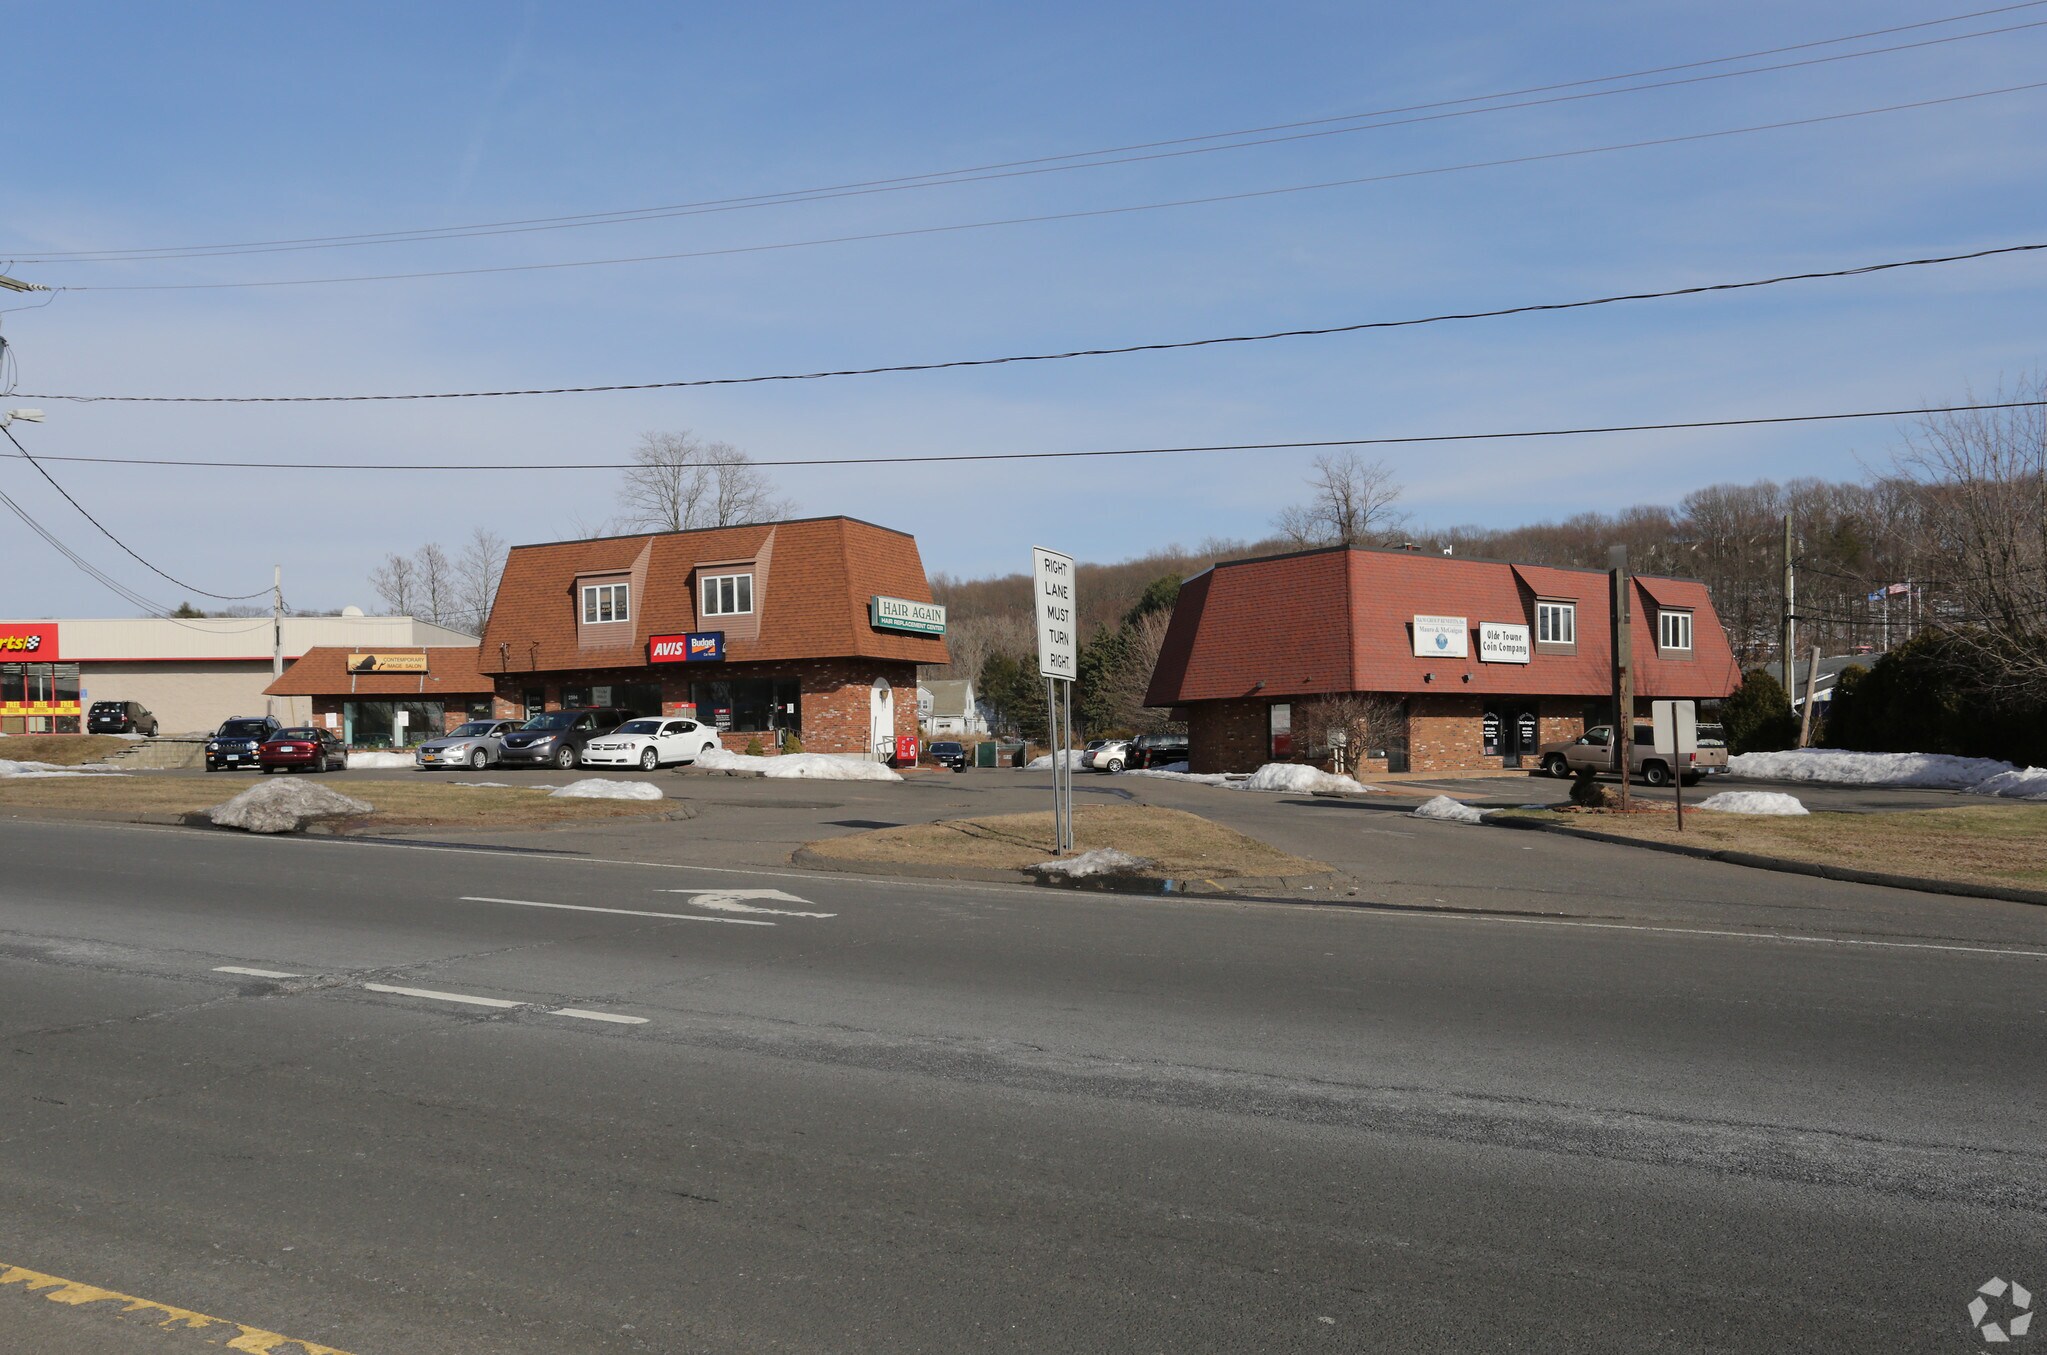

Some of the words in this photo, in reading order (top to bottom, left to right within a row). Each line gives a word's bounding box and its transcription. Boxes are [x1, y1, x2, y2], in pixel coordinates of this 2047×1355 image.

[1044, 558, 1067, 576] RIGHT
[1045, 581, 1068, 600] LANE
[883, 602, 908, 616] HAIR
[912, 606, 941, 622] AGAIN
[1047, 605, 1069, 623] MUST
[893, 618, 926, 629] REPLACEMENT
[691, 638, 715, 648] Budget
[1049, 629, 1069, 646] TURN
[1487, 630, 1500, 640] Olde
[1503, 631, 1522, 641] Towne
[653, 642, 683, 656] AVIS
[1483, 641, 1497, 651] Coin
[1499, 642, 1527, 655] Company
[1050, 653, 1069, 669] RIGHT
